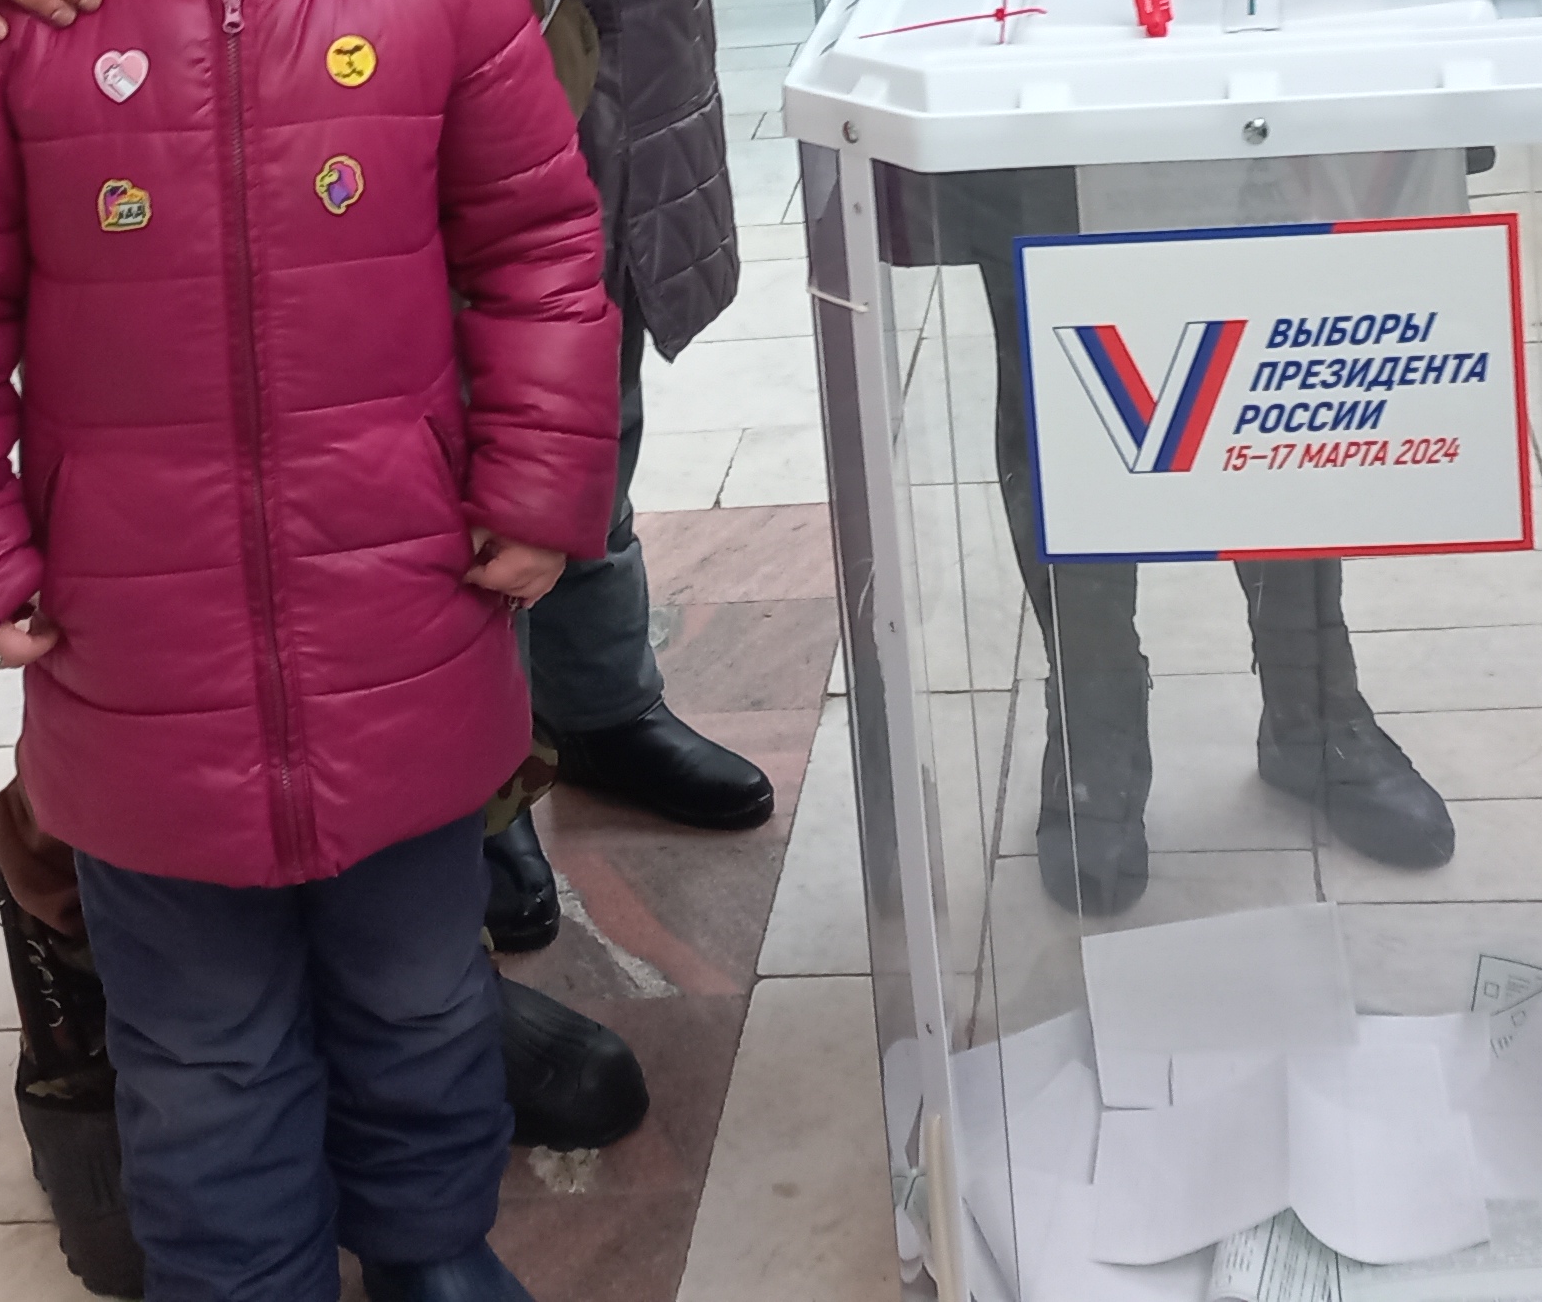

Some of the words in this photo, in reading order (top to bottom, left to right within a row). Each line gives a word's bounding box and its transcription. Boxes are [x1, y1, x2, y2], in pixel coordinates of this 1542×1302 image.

[1265, 311, 1439, 349] ВЫБОРЫ
[1248, 351, 1490, 393] ПРЕЗИДЕНТА
[1232, 399, 1389, 435] РОССИИ
[1297, 439, 1390, 468] МАРТА
[1394, 437, 1461, 466] 2024
